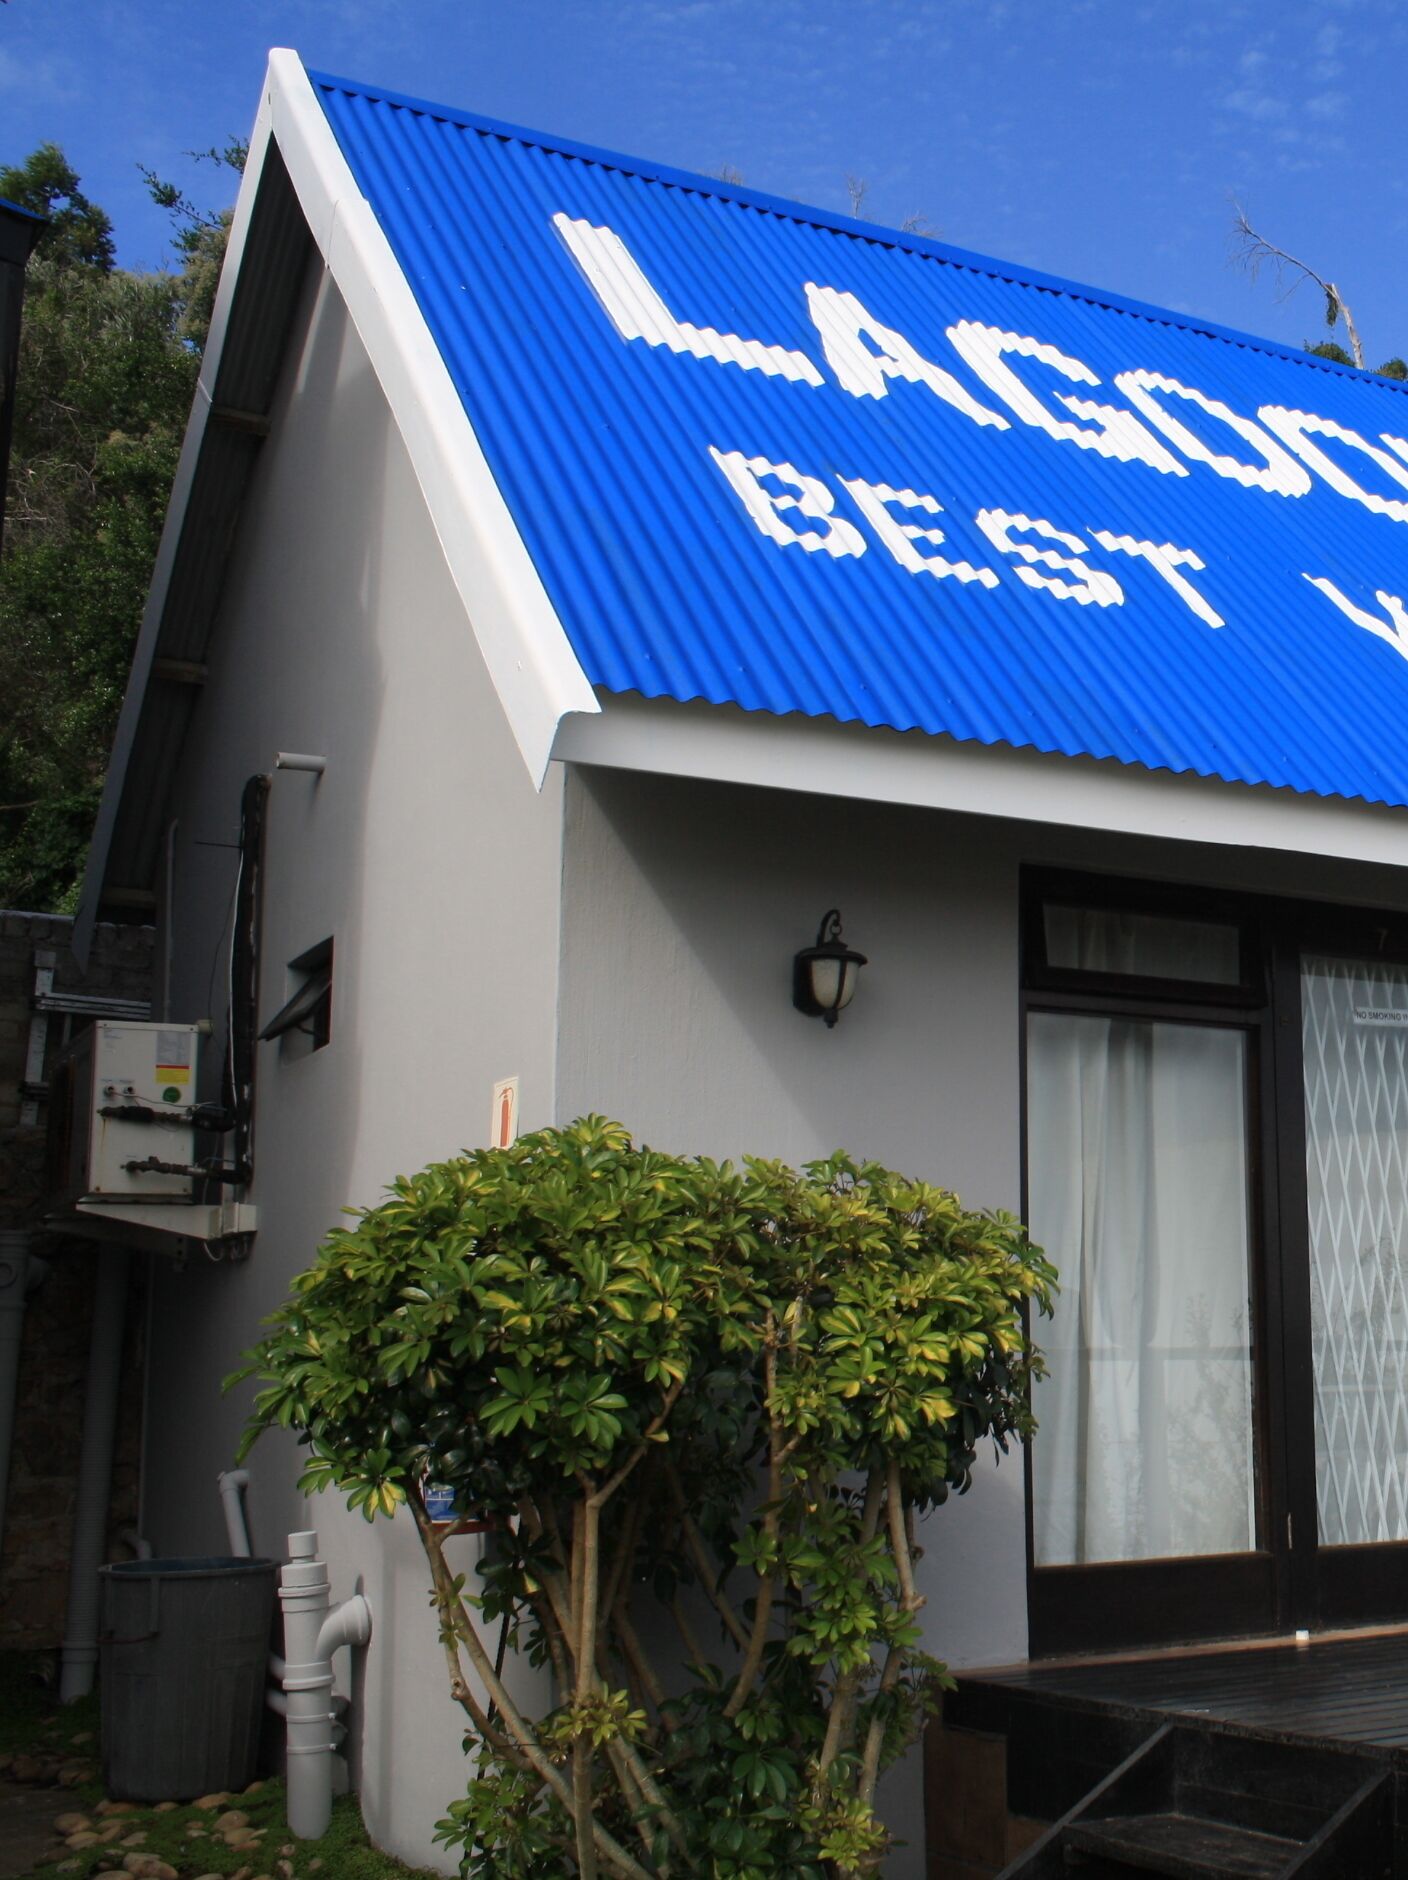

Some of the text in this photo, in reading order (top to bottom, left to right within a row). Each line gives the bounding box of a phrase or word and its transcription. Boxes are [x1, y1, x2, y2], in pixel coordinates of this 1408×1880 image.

[708, 445, 1226, 630] BEST
[1356, 1011, 1367, 1019] NO
[1368, 1012, 1402, 1021] SMOKING
